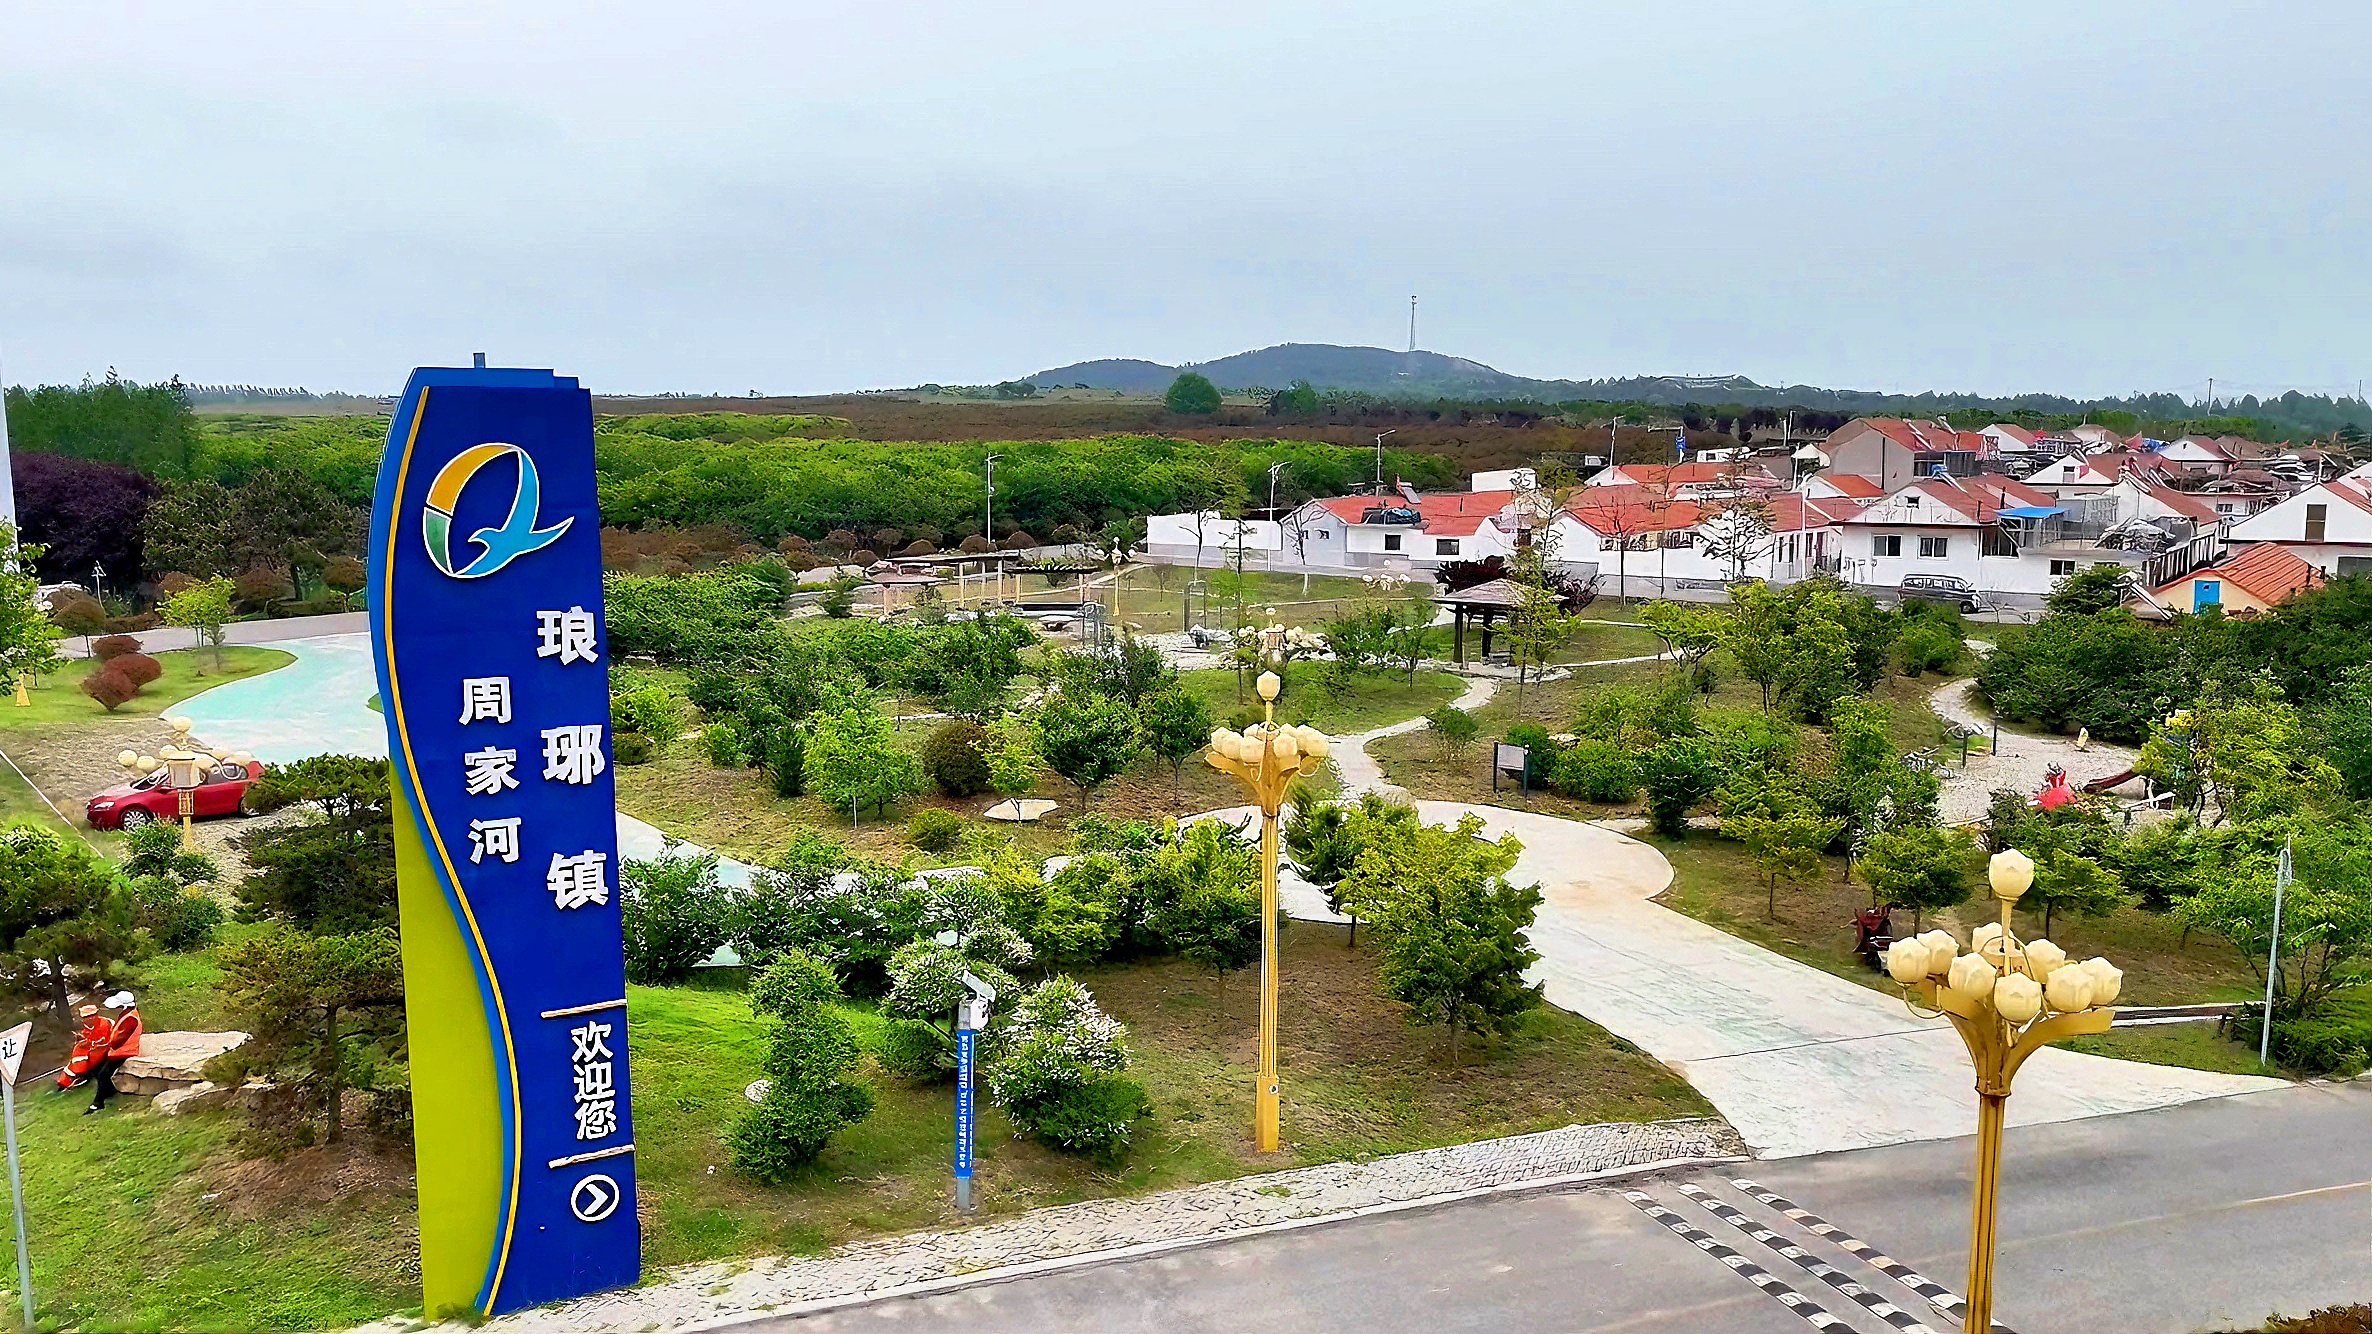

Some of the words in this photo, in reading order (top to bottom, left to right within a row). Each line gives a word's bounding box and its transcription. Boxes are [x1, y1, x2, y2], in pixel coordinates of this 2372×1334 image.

[459, 676, 521, 864] 周家河
[537, 606, 608, 909] 琅琊镇
[2, 1039, 18, 1059] 让
[570, 1020, 617, 1140] 欢迎您
